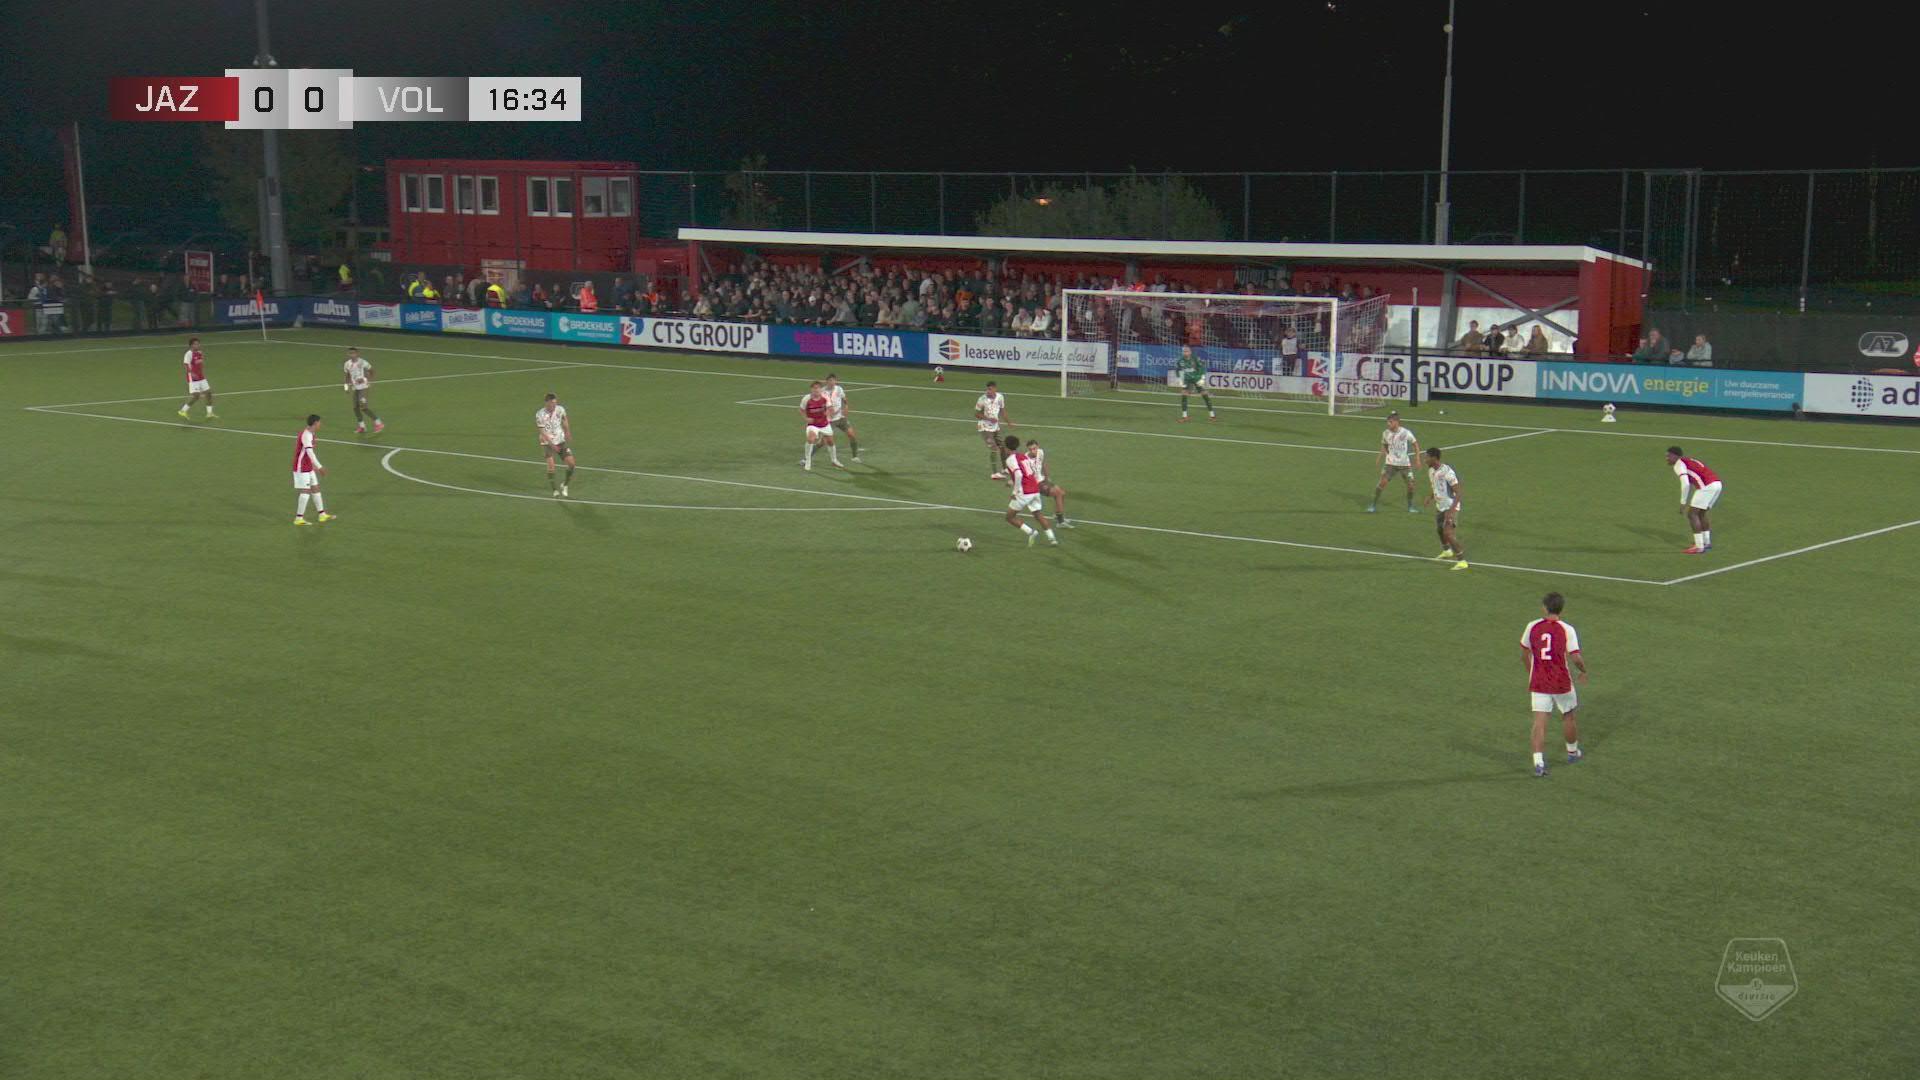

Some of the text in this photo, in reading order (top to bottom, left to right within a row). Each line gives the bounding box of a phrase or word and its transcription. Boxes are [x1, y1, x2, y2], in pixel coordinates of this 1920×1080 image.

[228, 300, 279, 317] LAVAZA
[313, 300, 351, 317] LAVAZZA
[570, 320, 615, 333] BROEKHUIS
[652, 321, 754, 349] CTS GROUP
[832, 332, 904, 359] LEBARA
[965, 344, 1097, 363] leaseweb reliable cloud
[1233, 359, 1265, 371] AFAS
[1357, 356, 1514, 392] CTS GROUP
[1209, 374, 1273, 389] CTS GROUP
[1337, 381, 1408, 398] CTS GROUP
[1542, 370, 1709, 397] INNOVA energie
[1541, 632, 1552, 660] 2
